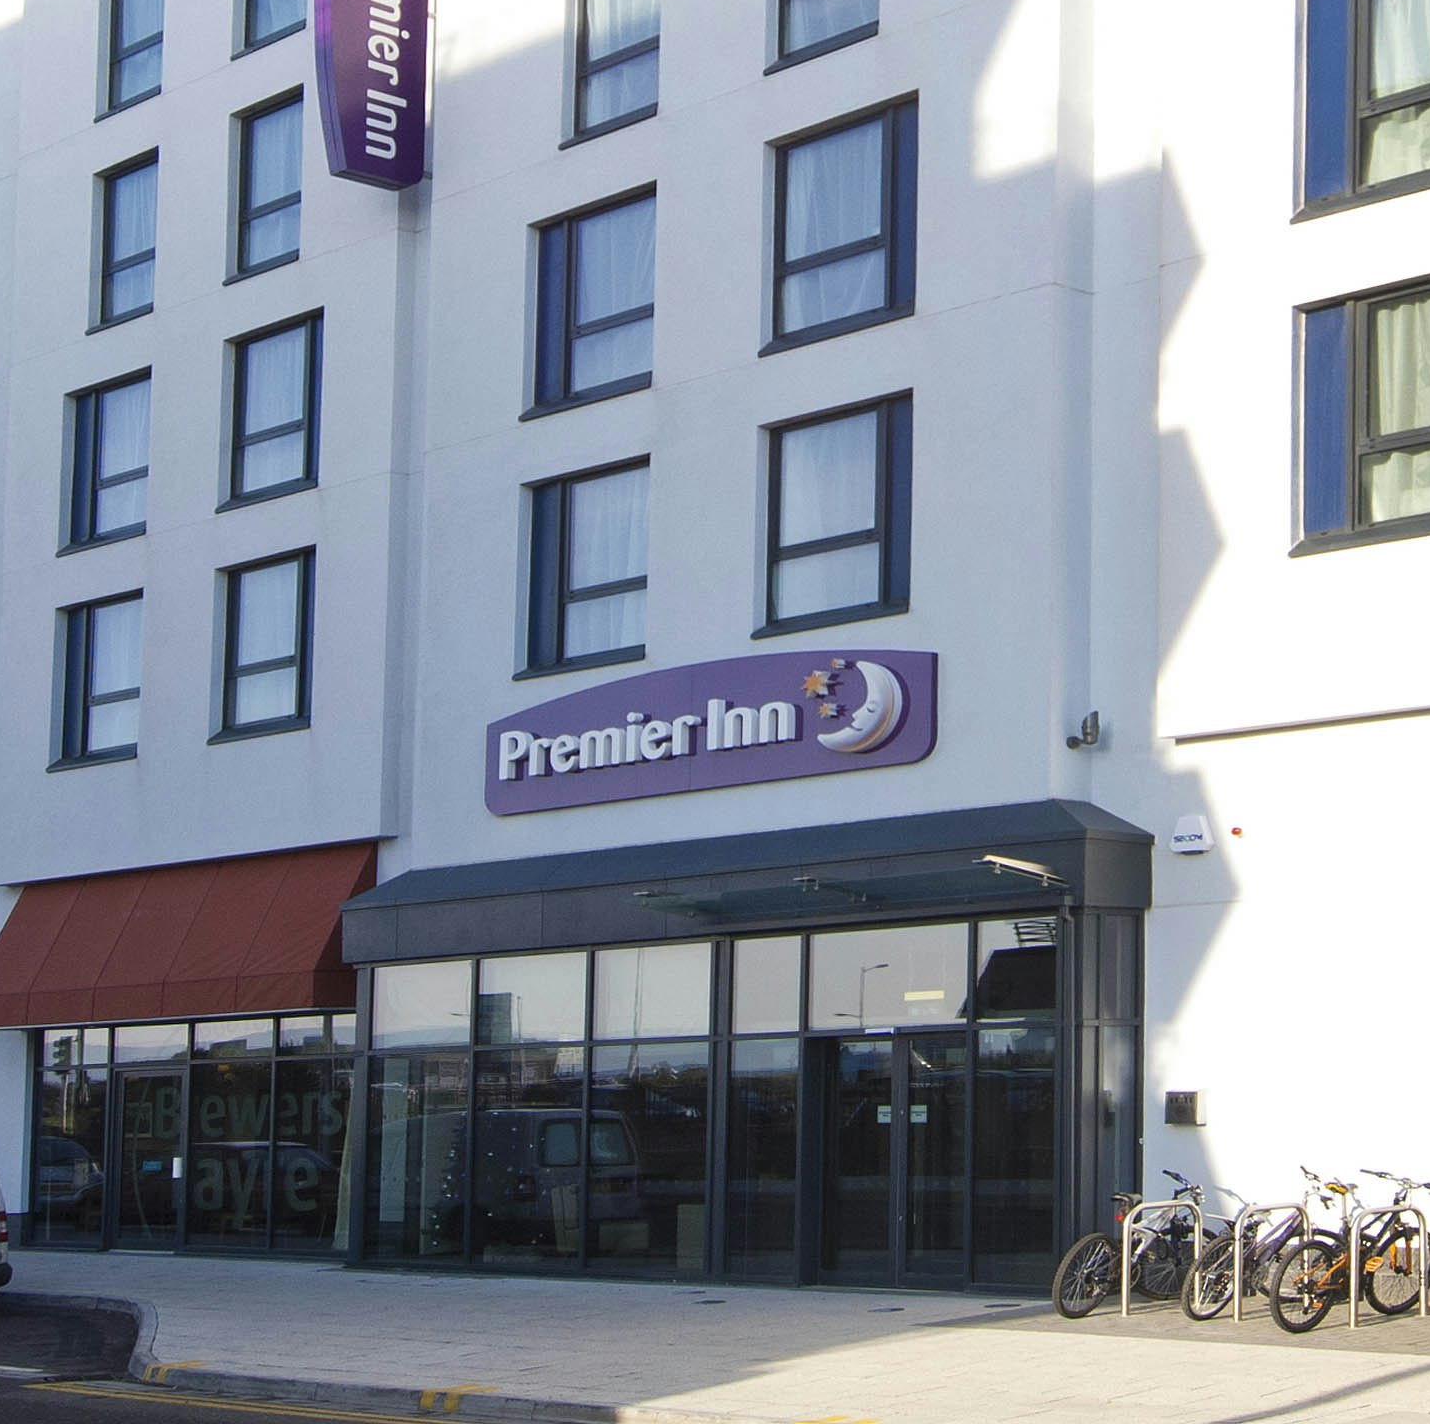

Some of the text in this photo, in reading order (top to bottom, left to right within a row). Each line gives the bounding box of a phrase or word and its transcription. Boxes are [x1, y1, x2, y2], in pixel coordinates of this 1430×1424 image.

[365, 89, 407, 160] Inn
[499, 699, 796, 780] Premier Inn
[154, 1087, 343, 1138] Bewers
